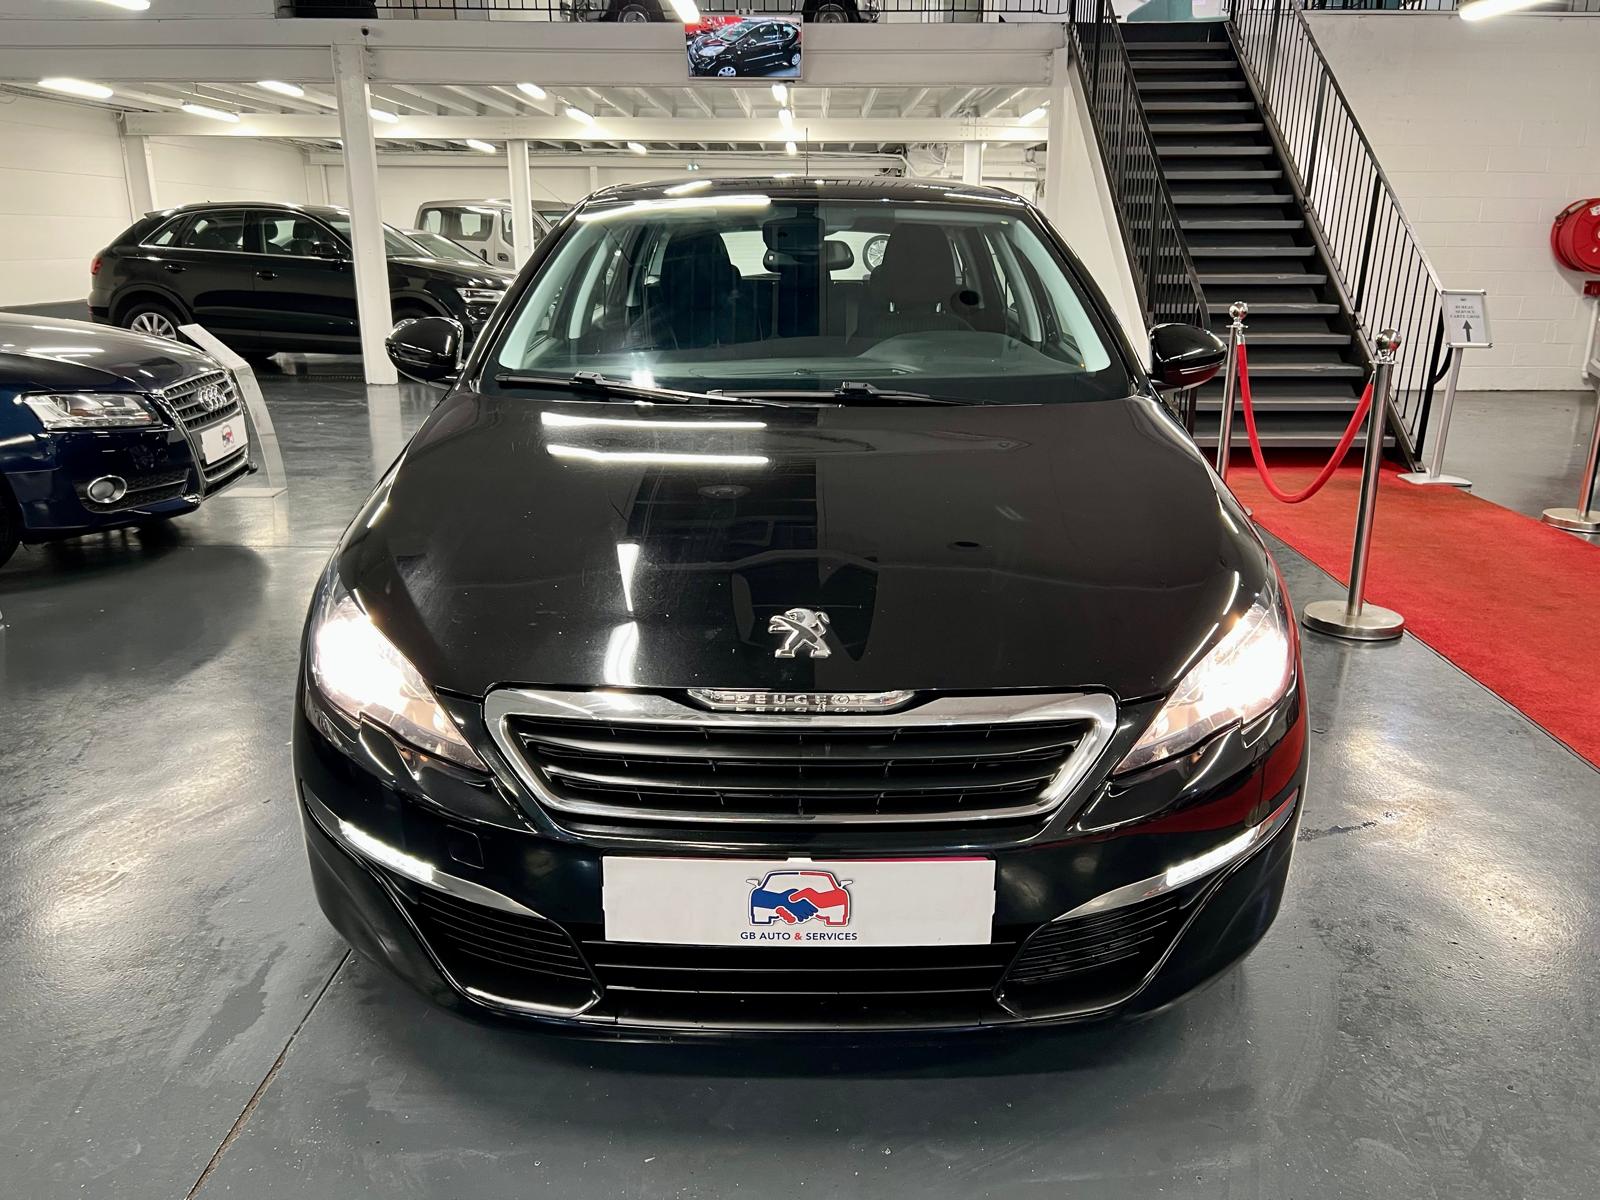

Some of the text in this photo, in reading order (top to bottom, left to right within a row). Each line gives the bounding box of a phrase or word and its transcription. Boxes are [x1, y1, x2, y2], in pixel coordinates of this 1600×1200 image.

[740, 931, 858, 941] GB AUTO & SERVICES
